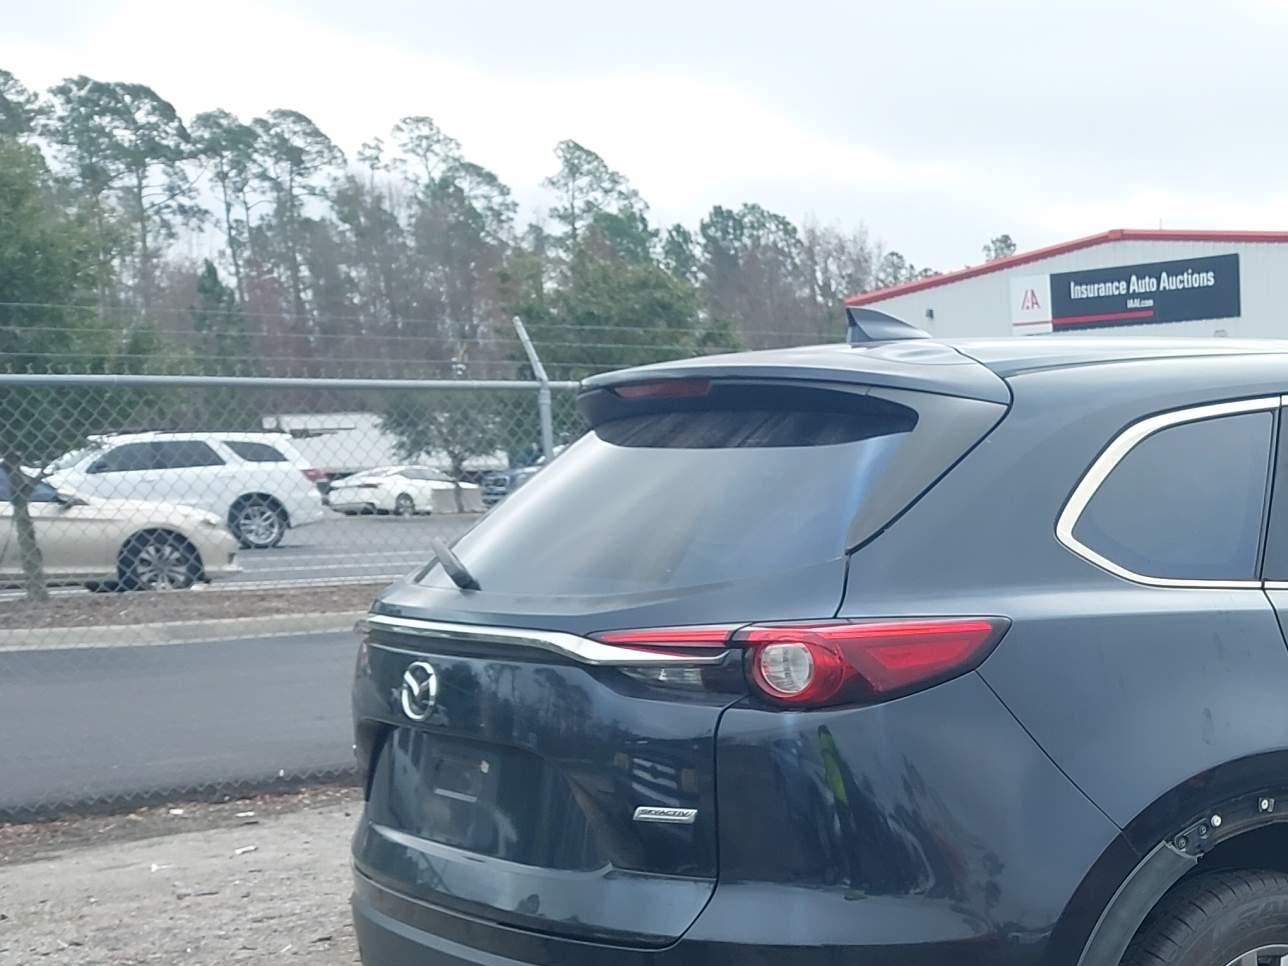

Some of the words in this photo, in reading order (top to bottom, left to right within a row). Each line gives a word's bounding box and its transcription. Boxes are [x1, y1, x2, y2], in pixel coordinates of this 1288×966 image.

[1070, 280, 1127, 299] Insurance
[1129, 274, 1157, 294] Auto
[1159, 268, 1215, 291] Auctions
